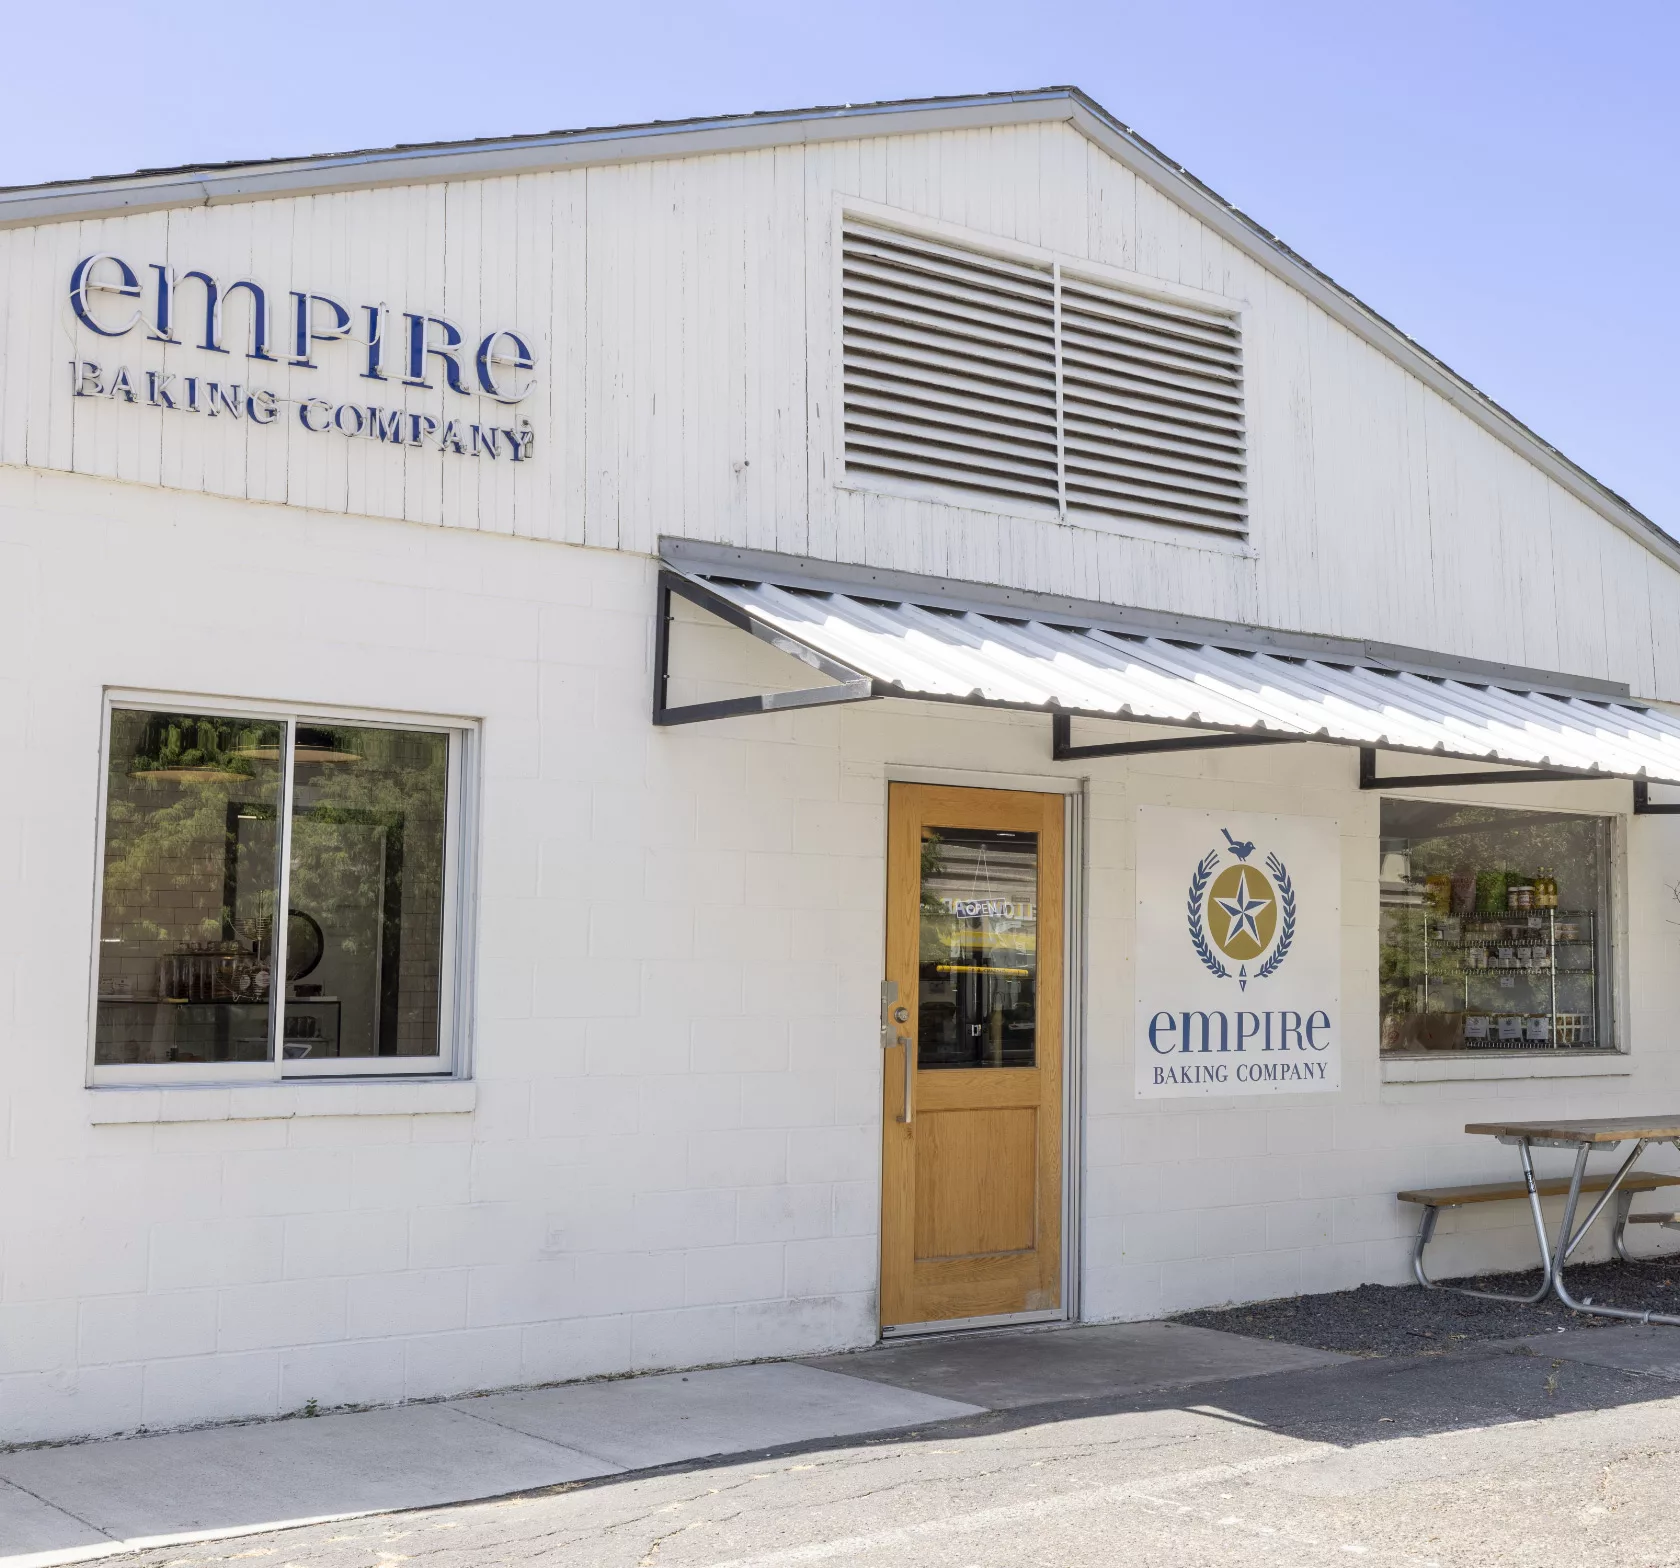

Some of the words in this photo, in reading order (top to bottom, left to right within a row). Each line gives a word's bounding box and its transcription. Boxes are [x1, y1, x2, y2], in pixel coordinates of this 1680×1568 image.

[69, 361, 280, 424] BAKING
[299, 398, 529, 461] COMPANY
[966, 903, 997, 916] OPEN
[1153, 1064, 1228, 1085] BAKING
[1236, 1062, 1328, 1082] COMPANY
